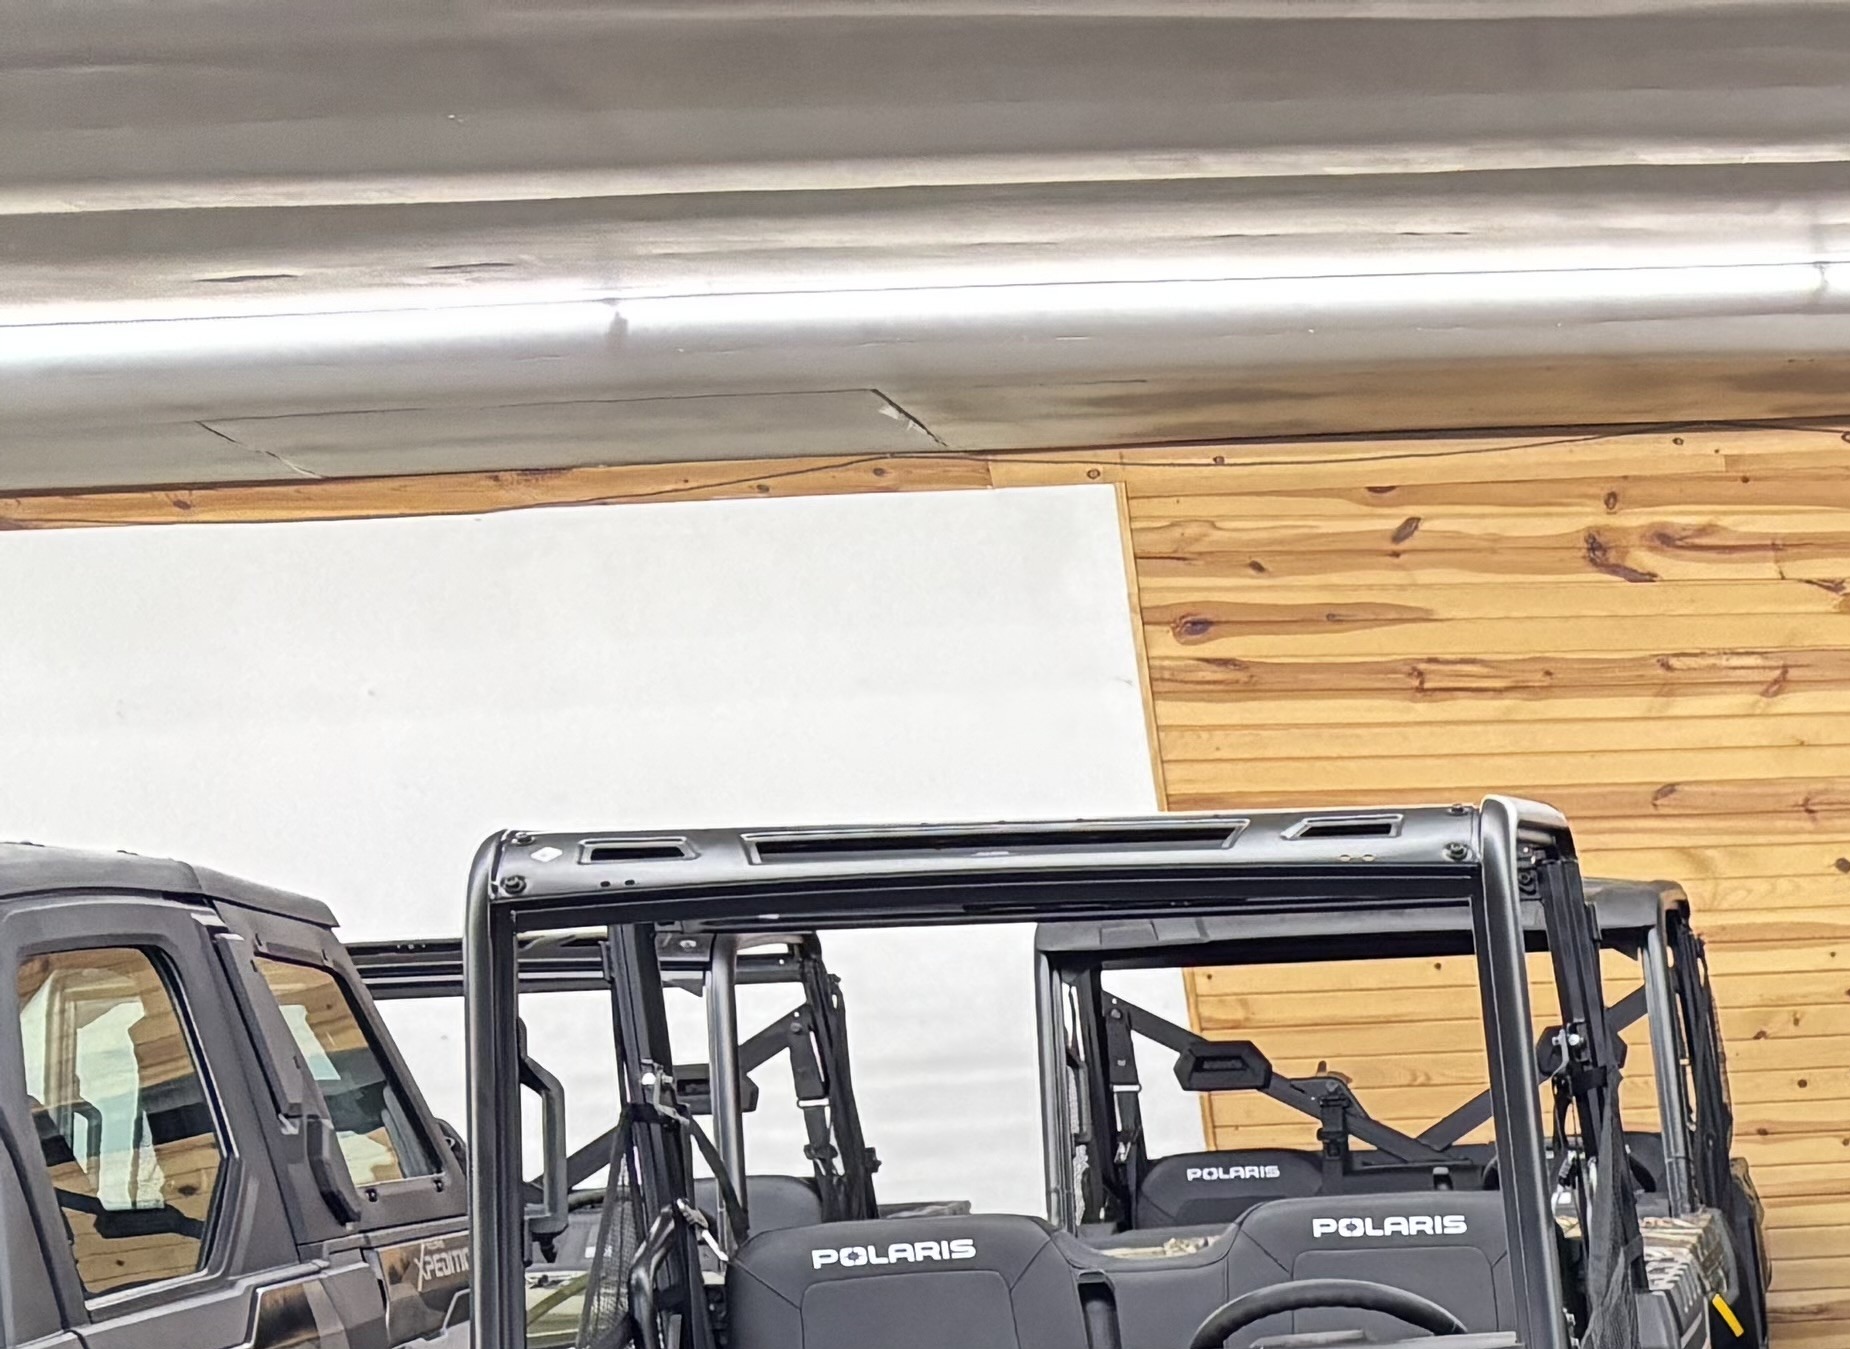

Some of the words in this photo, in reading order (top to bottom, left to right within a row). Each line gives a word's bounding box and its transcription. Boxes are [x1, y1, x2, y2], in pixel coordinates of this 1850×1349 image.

[1187, 1165, 1280, 1181] POLARIS
[1312, 1214, 1467, 1238] POLARIS
[811, 1239, 976, 1269] POLARIS
